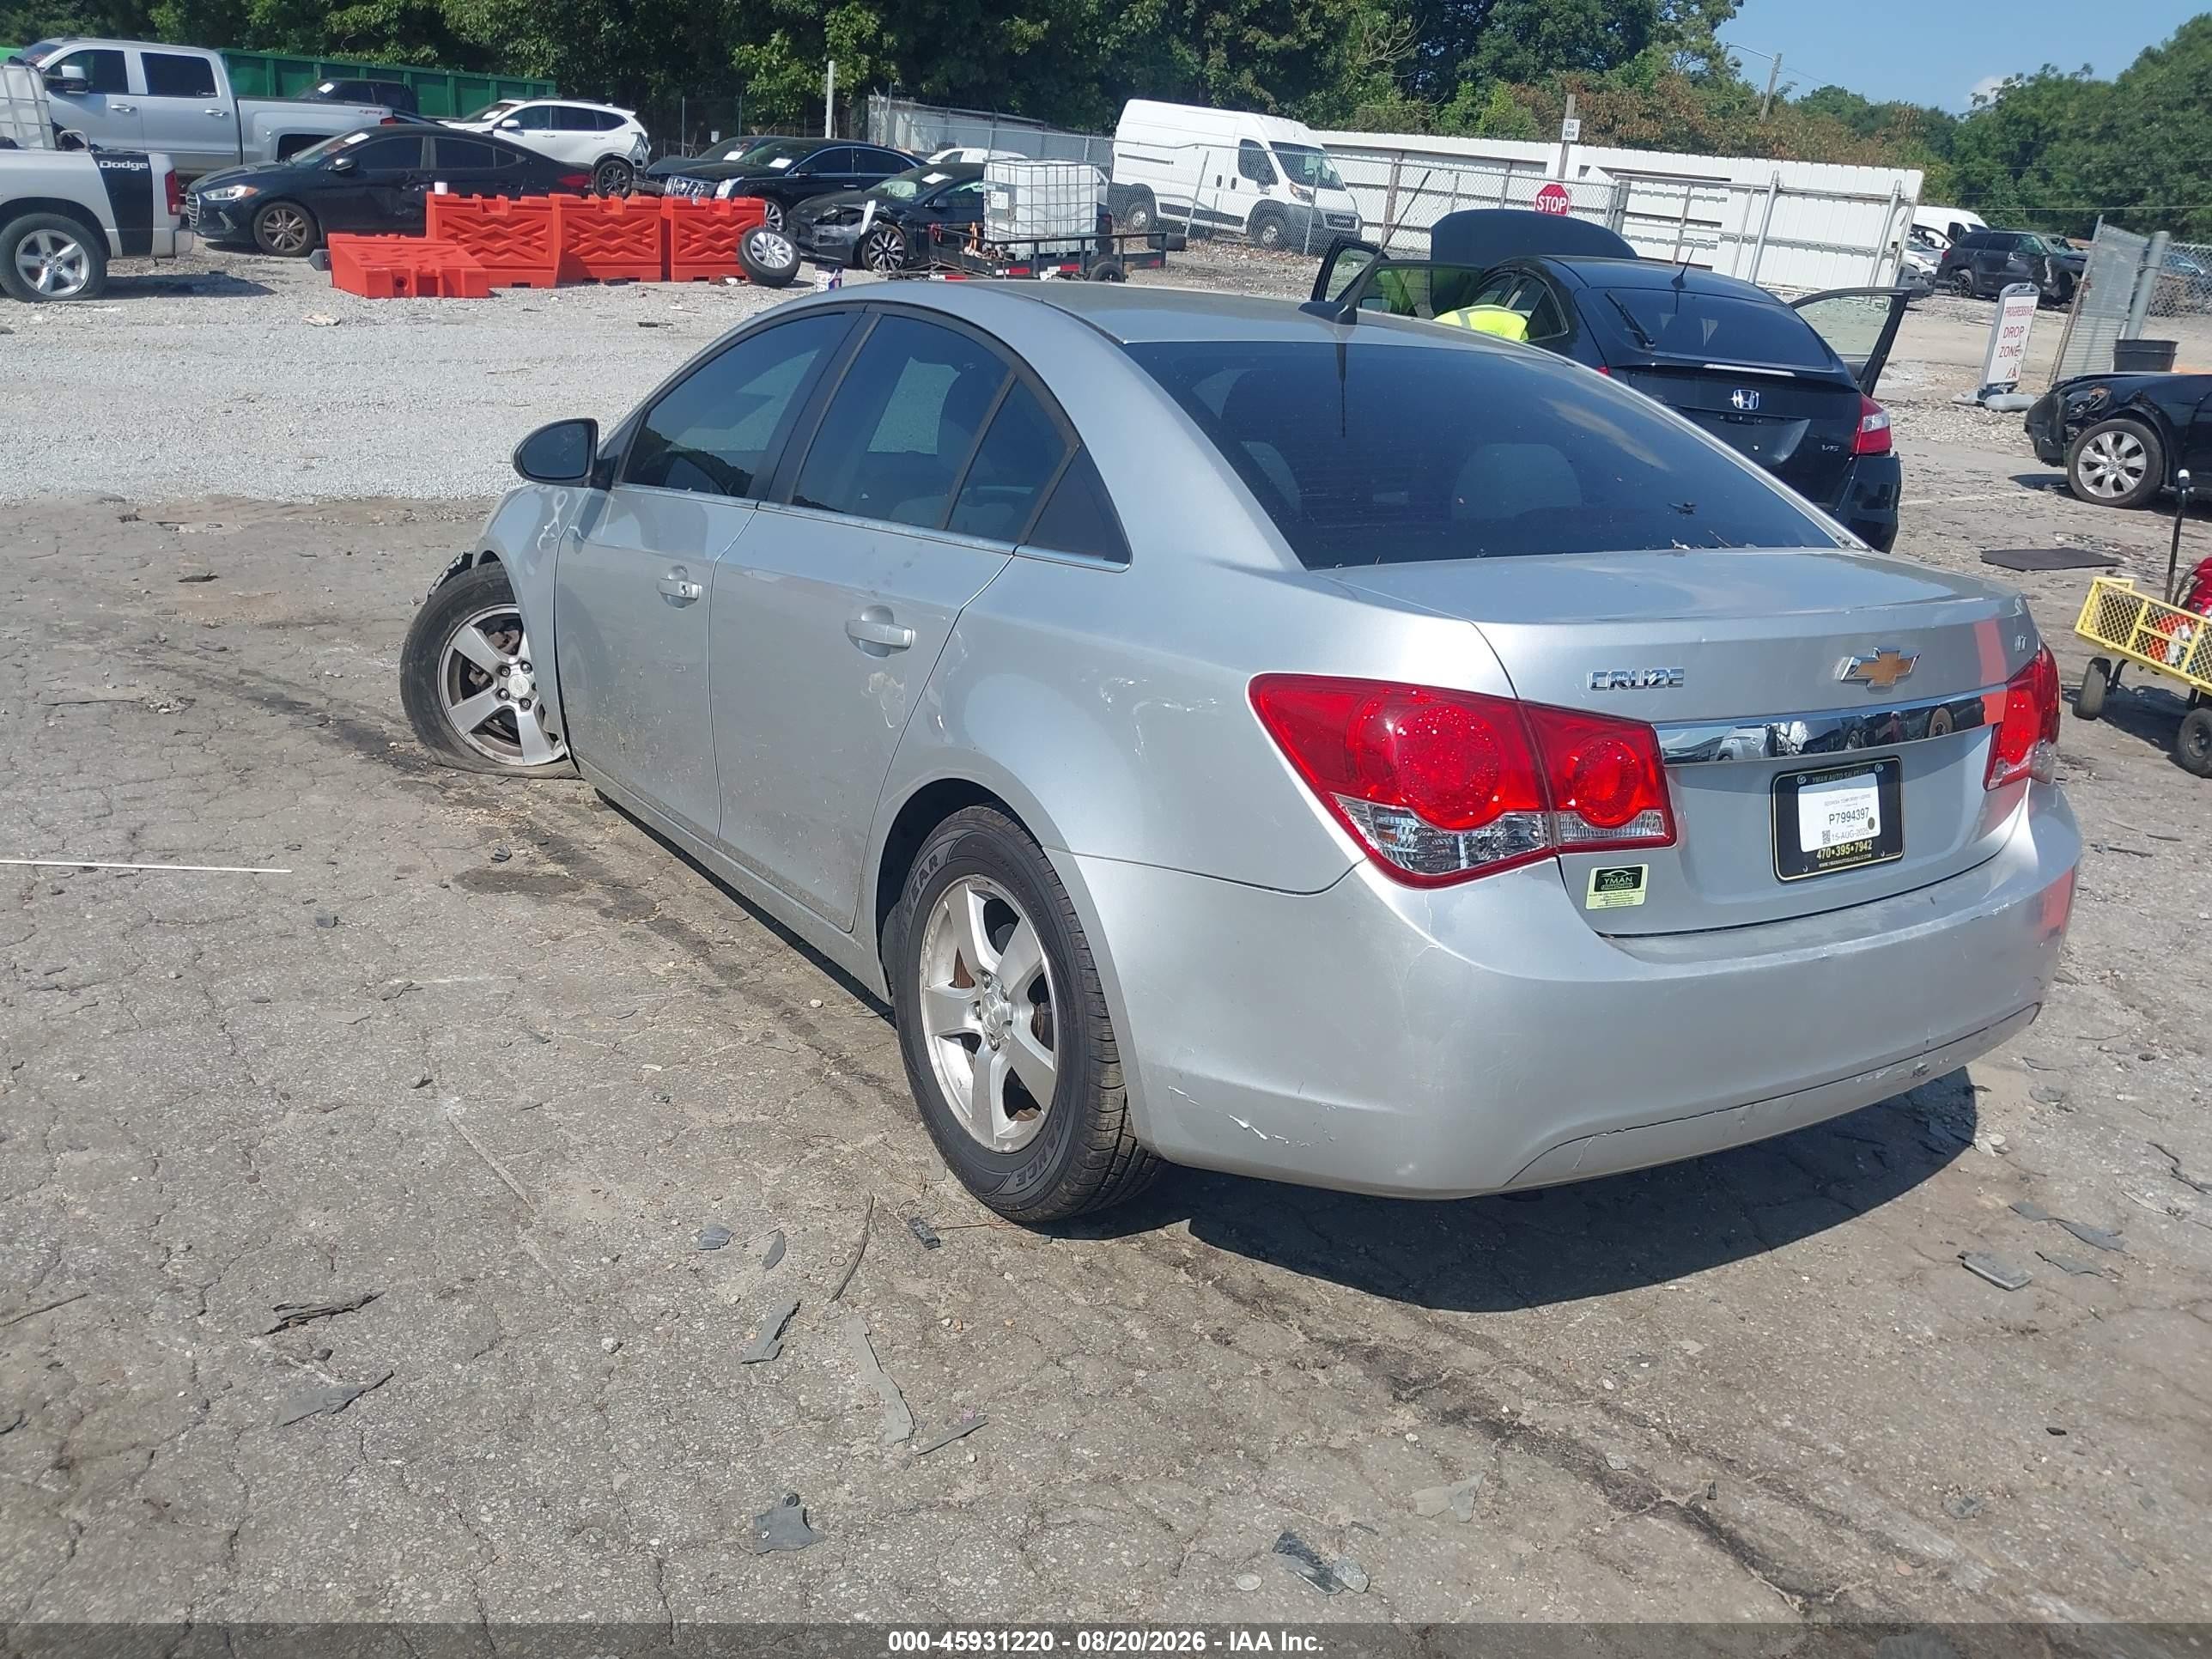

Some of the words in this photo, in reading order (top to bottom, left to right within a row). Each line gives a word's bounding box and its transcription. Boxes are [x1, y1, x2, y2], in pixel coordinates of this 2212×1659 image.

[99, 161, 149, 171] Dodge
[1536, 195, 1567, 212] STOP
[2002, 326, 2025, 338] DROP
[1998, 345, 2021, 358] ZONE
[1587, 667, 1684, 690] CRUZE
[1828, 772, 1843, 781] AUTO
[1828, 807, 1869, 825] P7994397
[1603, 876, 1633, 885] YMAN
